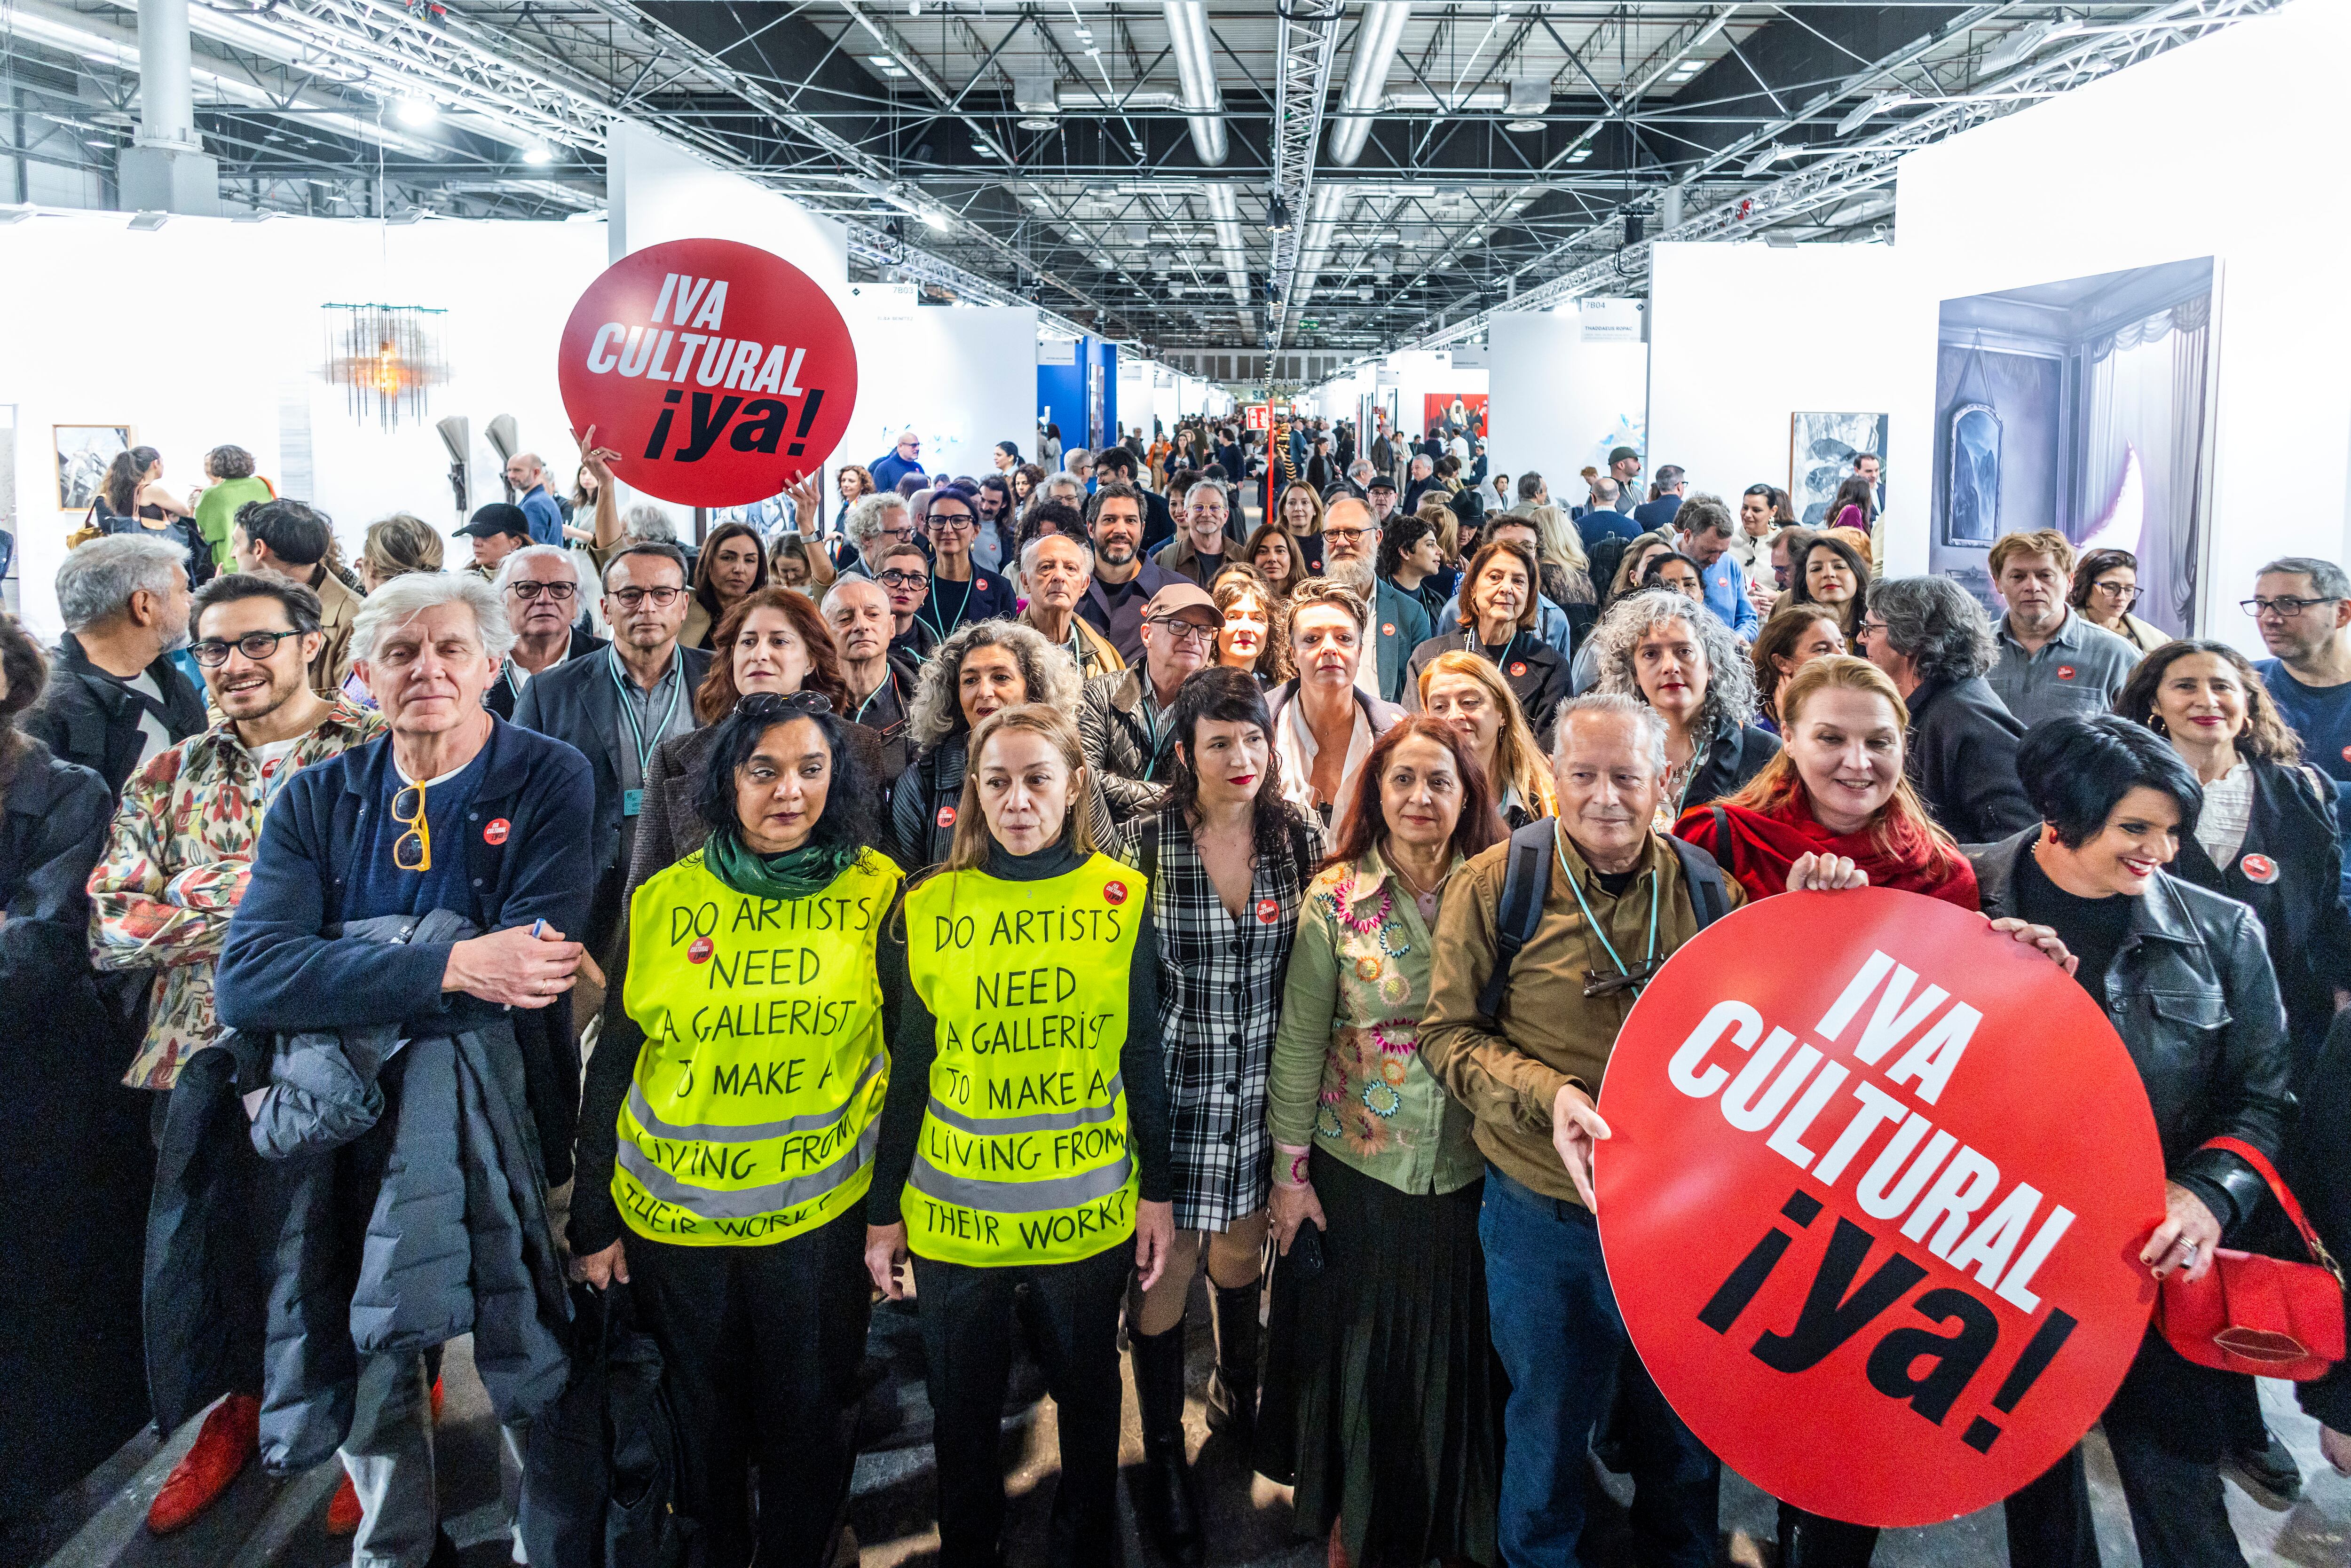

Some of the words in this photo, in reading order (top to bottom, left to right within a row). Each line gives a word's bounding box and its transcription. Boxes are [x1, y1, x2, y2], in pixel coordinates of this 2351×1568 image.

[651, 273, 728, 331] IVA
[587, 323, 806, 397] CULTURAL
[644, 389, 825, 462] ¡ya!
[1106, 886, 1124, 897] CULTURAL
[1259, 906, 1275, 915] CULTURAL
[672, 902, 719, 947] DO
[935, 915, 975, 953] DO
[710, 947, 820, 990] NEED
[976, 967, 1076, 1010] NEED
[662, 1009, 680, 1043] A
[947, 1021, 963, 1052] A
[1815, 949, 1983, 1106] IVA
[713, 1058, 806, 1096] MAKE
[946, 1067, 970, 1105] TO
[989, 1072, 1077, 1110] MAKE
[1088, 1068, 1107, 1100] A
[781, 1113, 855, 1172] FROM
[1055, 1123, 1125, 1169] FROM
[1667, 1000, 2076, 1315] CULTURAL
[1018, 1189, 1128, 1250] WORK?
[1697, 1189, 2079, 1455] ¡ya!
